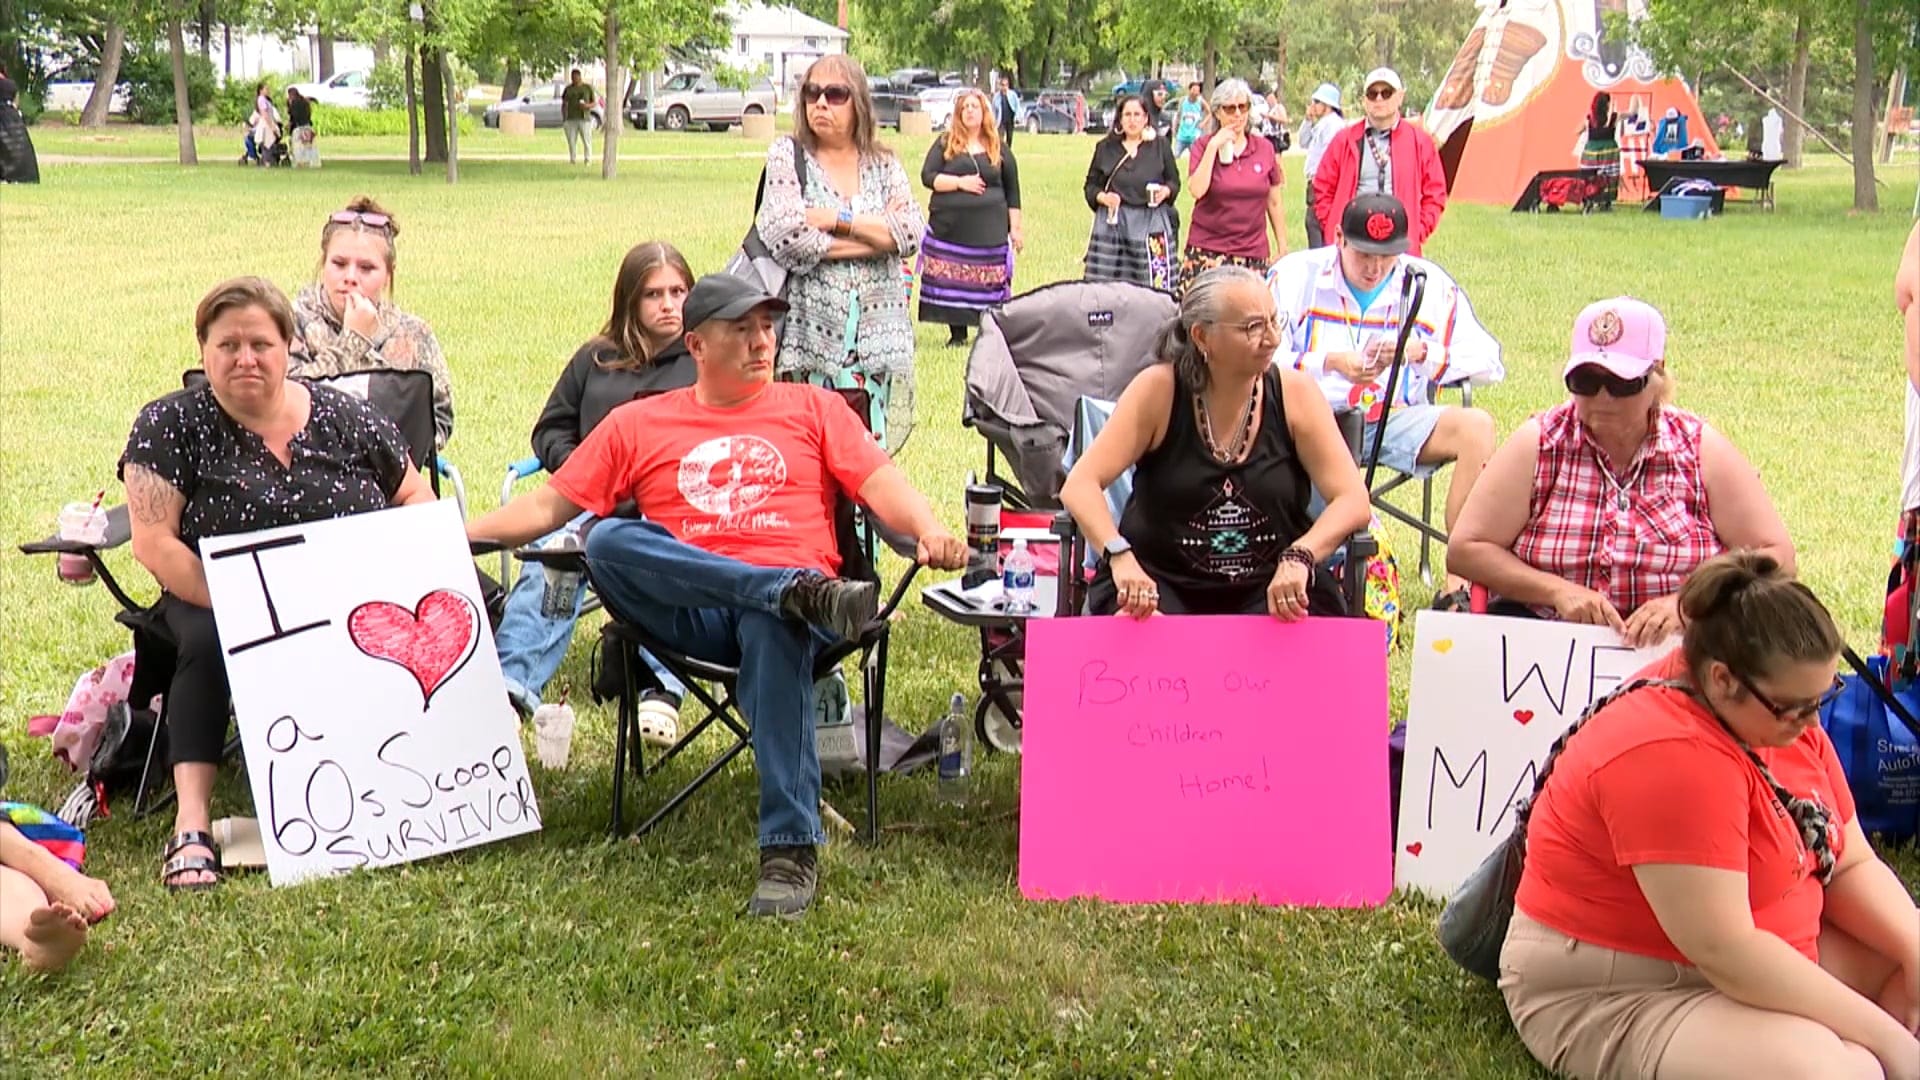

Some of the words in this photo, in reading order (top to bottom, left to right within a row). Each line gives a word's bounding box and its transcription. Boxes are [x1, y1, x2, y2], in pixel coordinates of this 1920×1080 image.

[210, 533, 331, 656] I
[1078, 660, 1190, 709] Bring
[1223, 671, 1271, 692] Our
[266, 715, 323, 753] a
[1127, 723, 1222, 747] Children
[377, 731, 512, 808] Scoop
[1179, 754, 1271, 798] Home!
